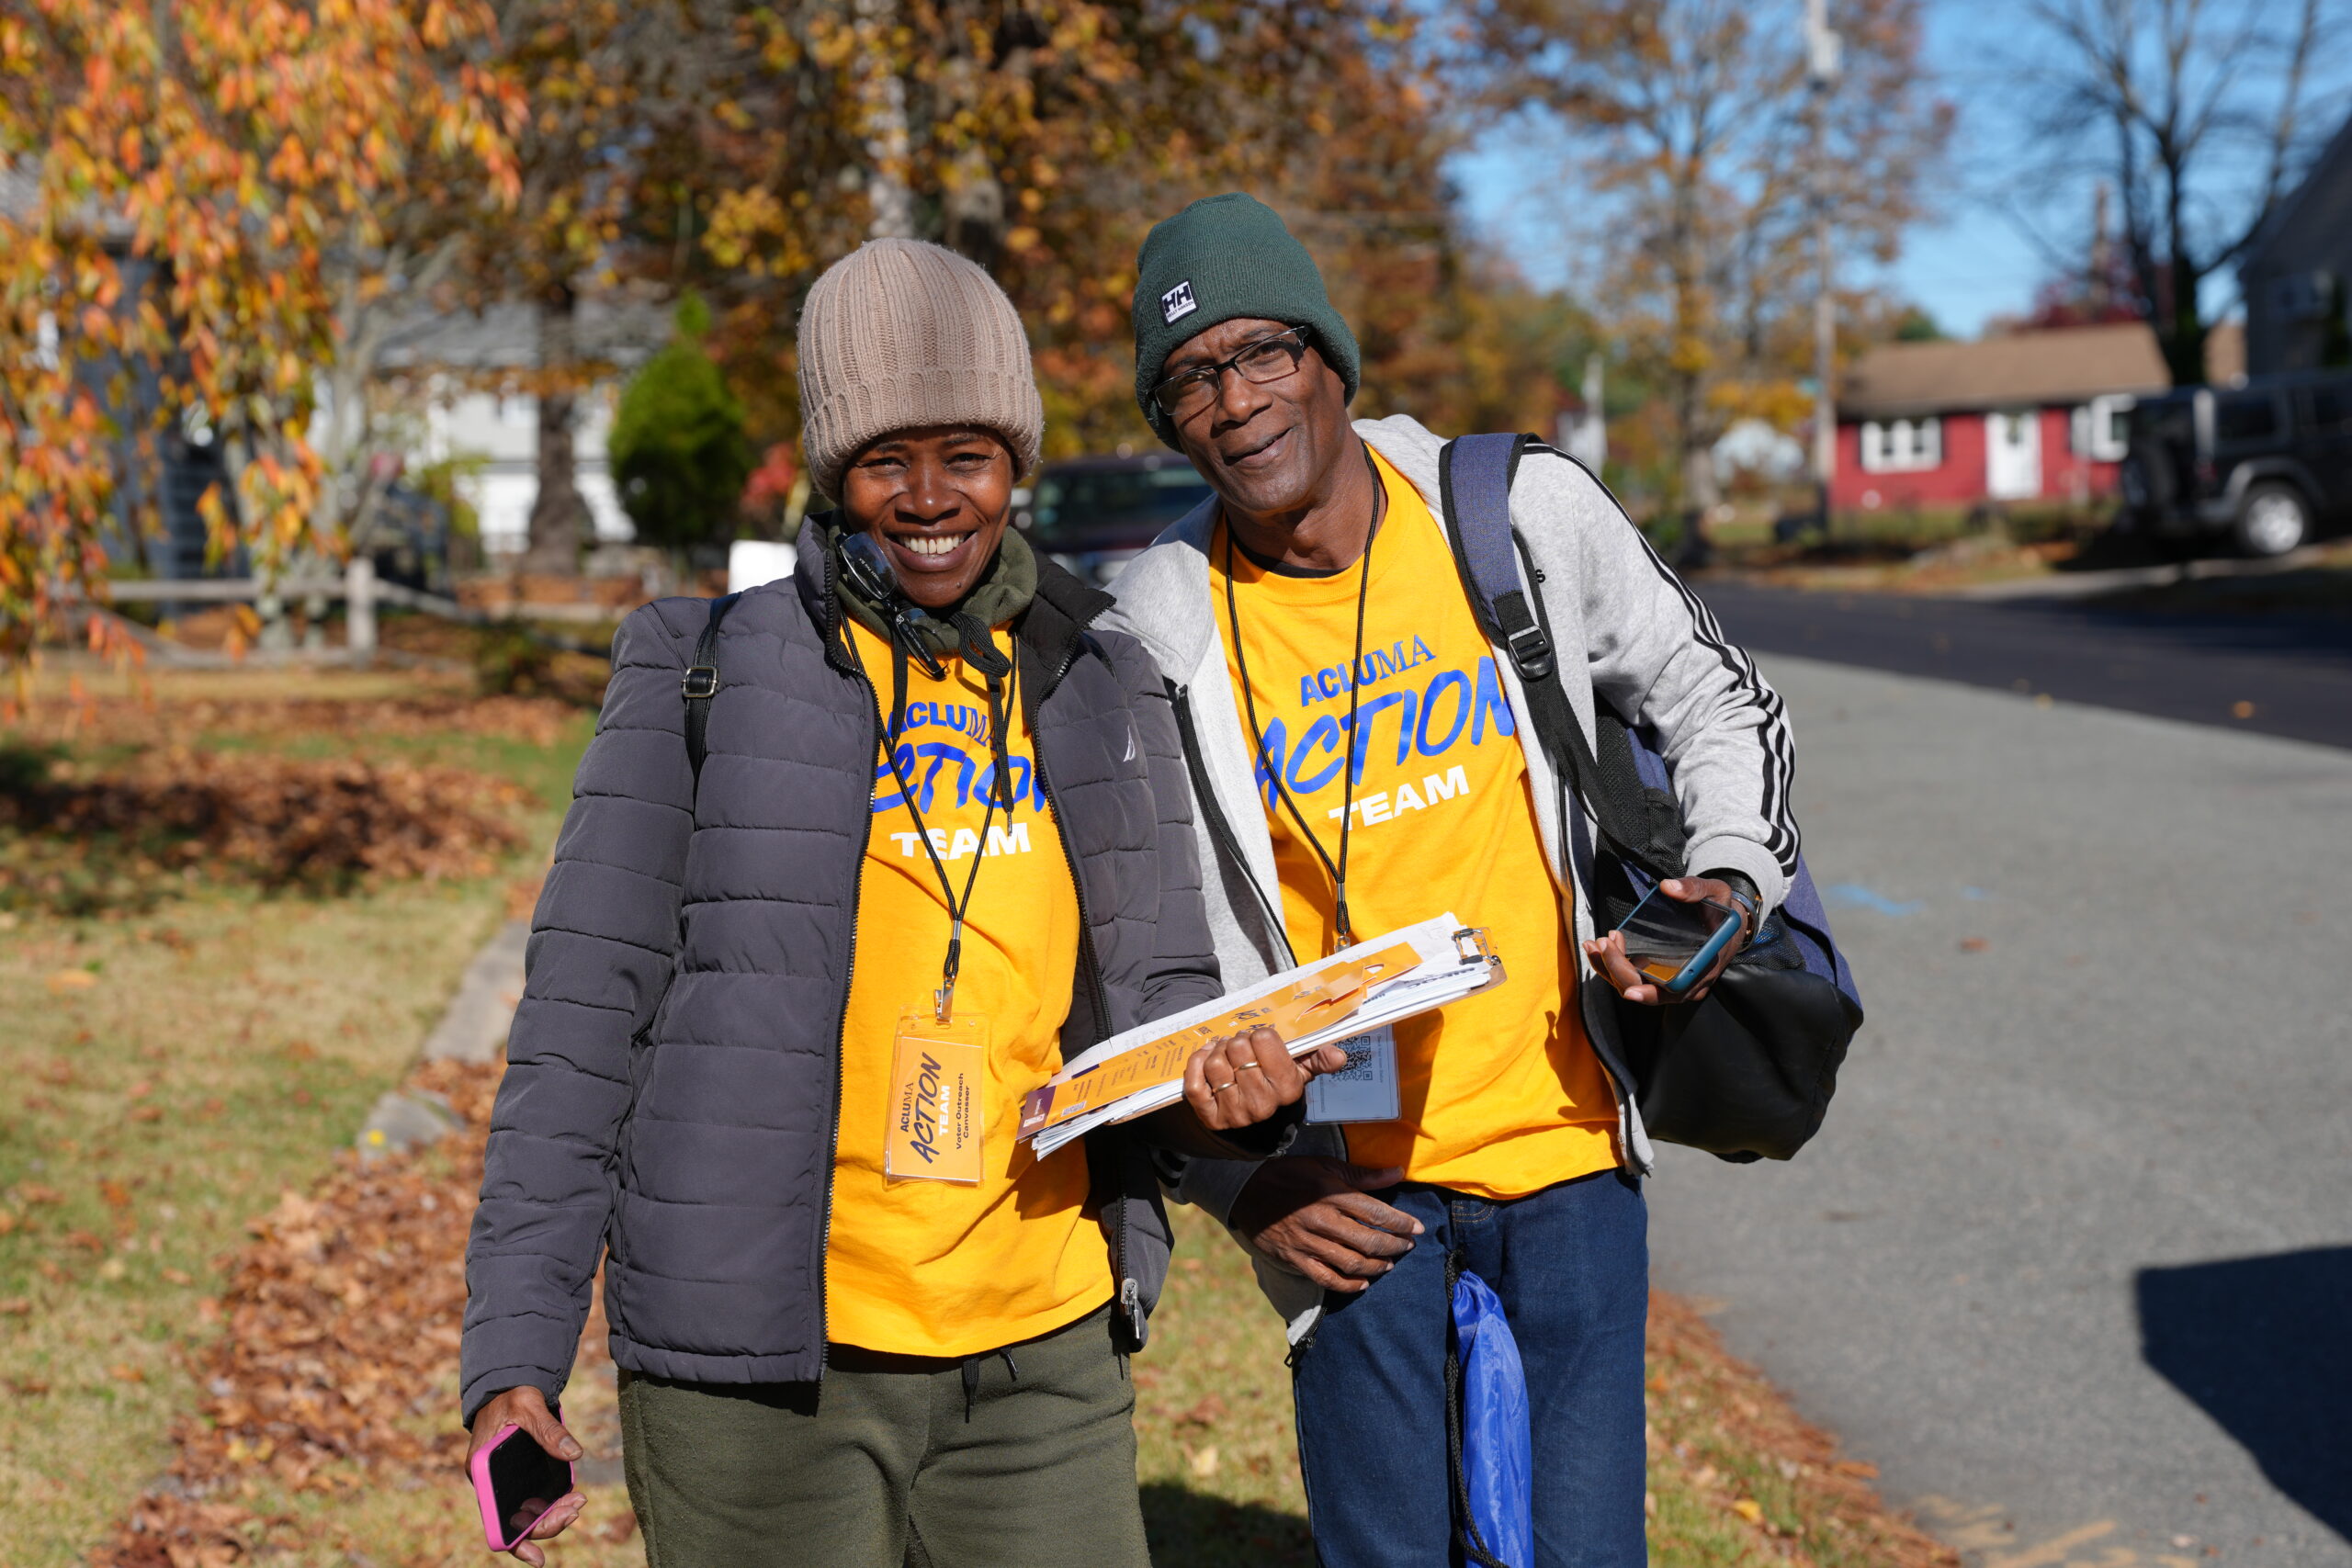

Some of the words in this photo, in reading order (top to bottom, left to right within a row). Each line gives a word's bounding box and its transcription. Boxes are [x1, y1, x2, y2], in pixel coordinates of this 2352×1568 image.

[1163, 284, 1193, 314] HH
[1300, 634, 1437, 707] ACLUMA
[1328, 764, 1471, 832] TEAM
[890, 822, 1032, 861] TEAM
[899, 1082, 914, 1133] ACLUMA
[910, 1051, 942, 1164] ACTION
[938, 1085, 951, 1136] TEAM
